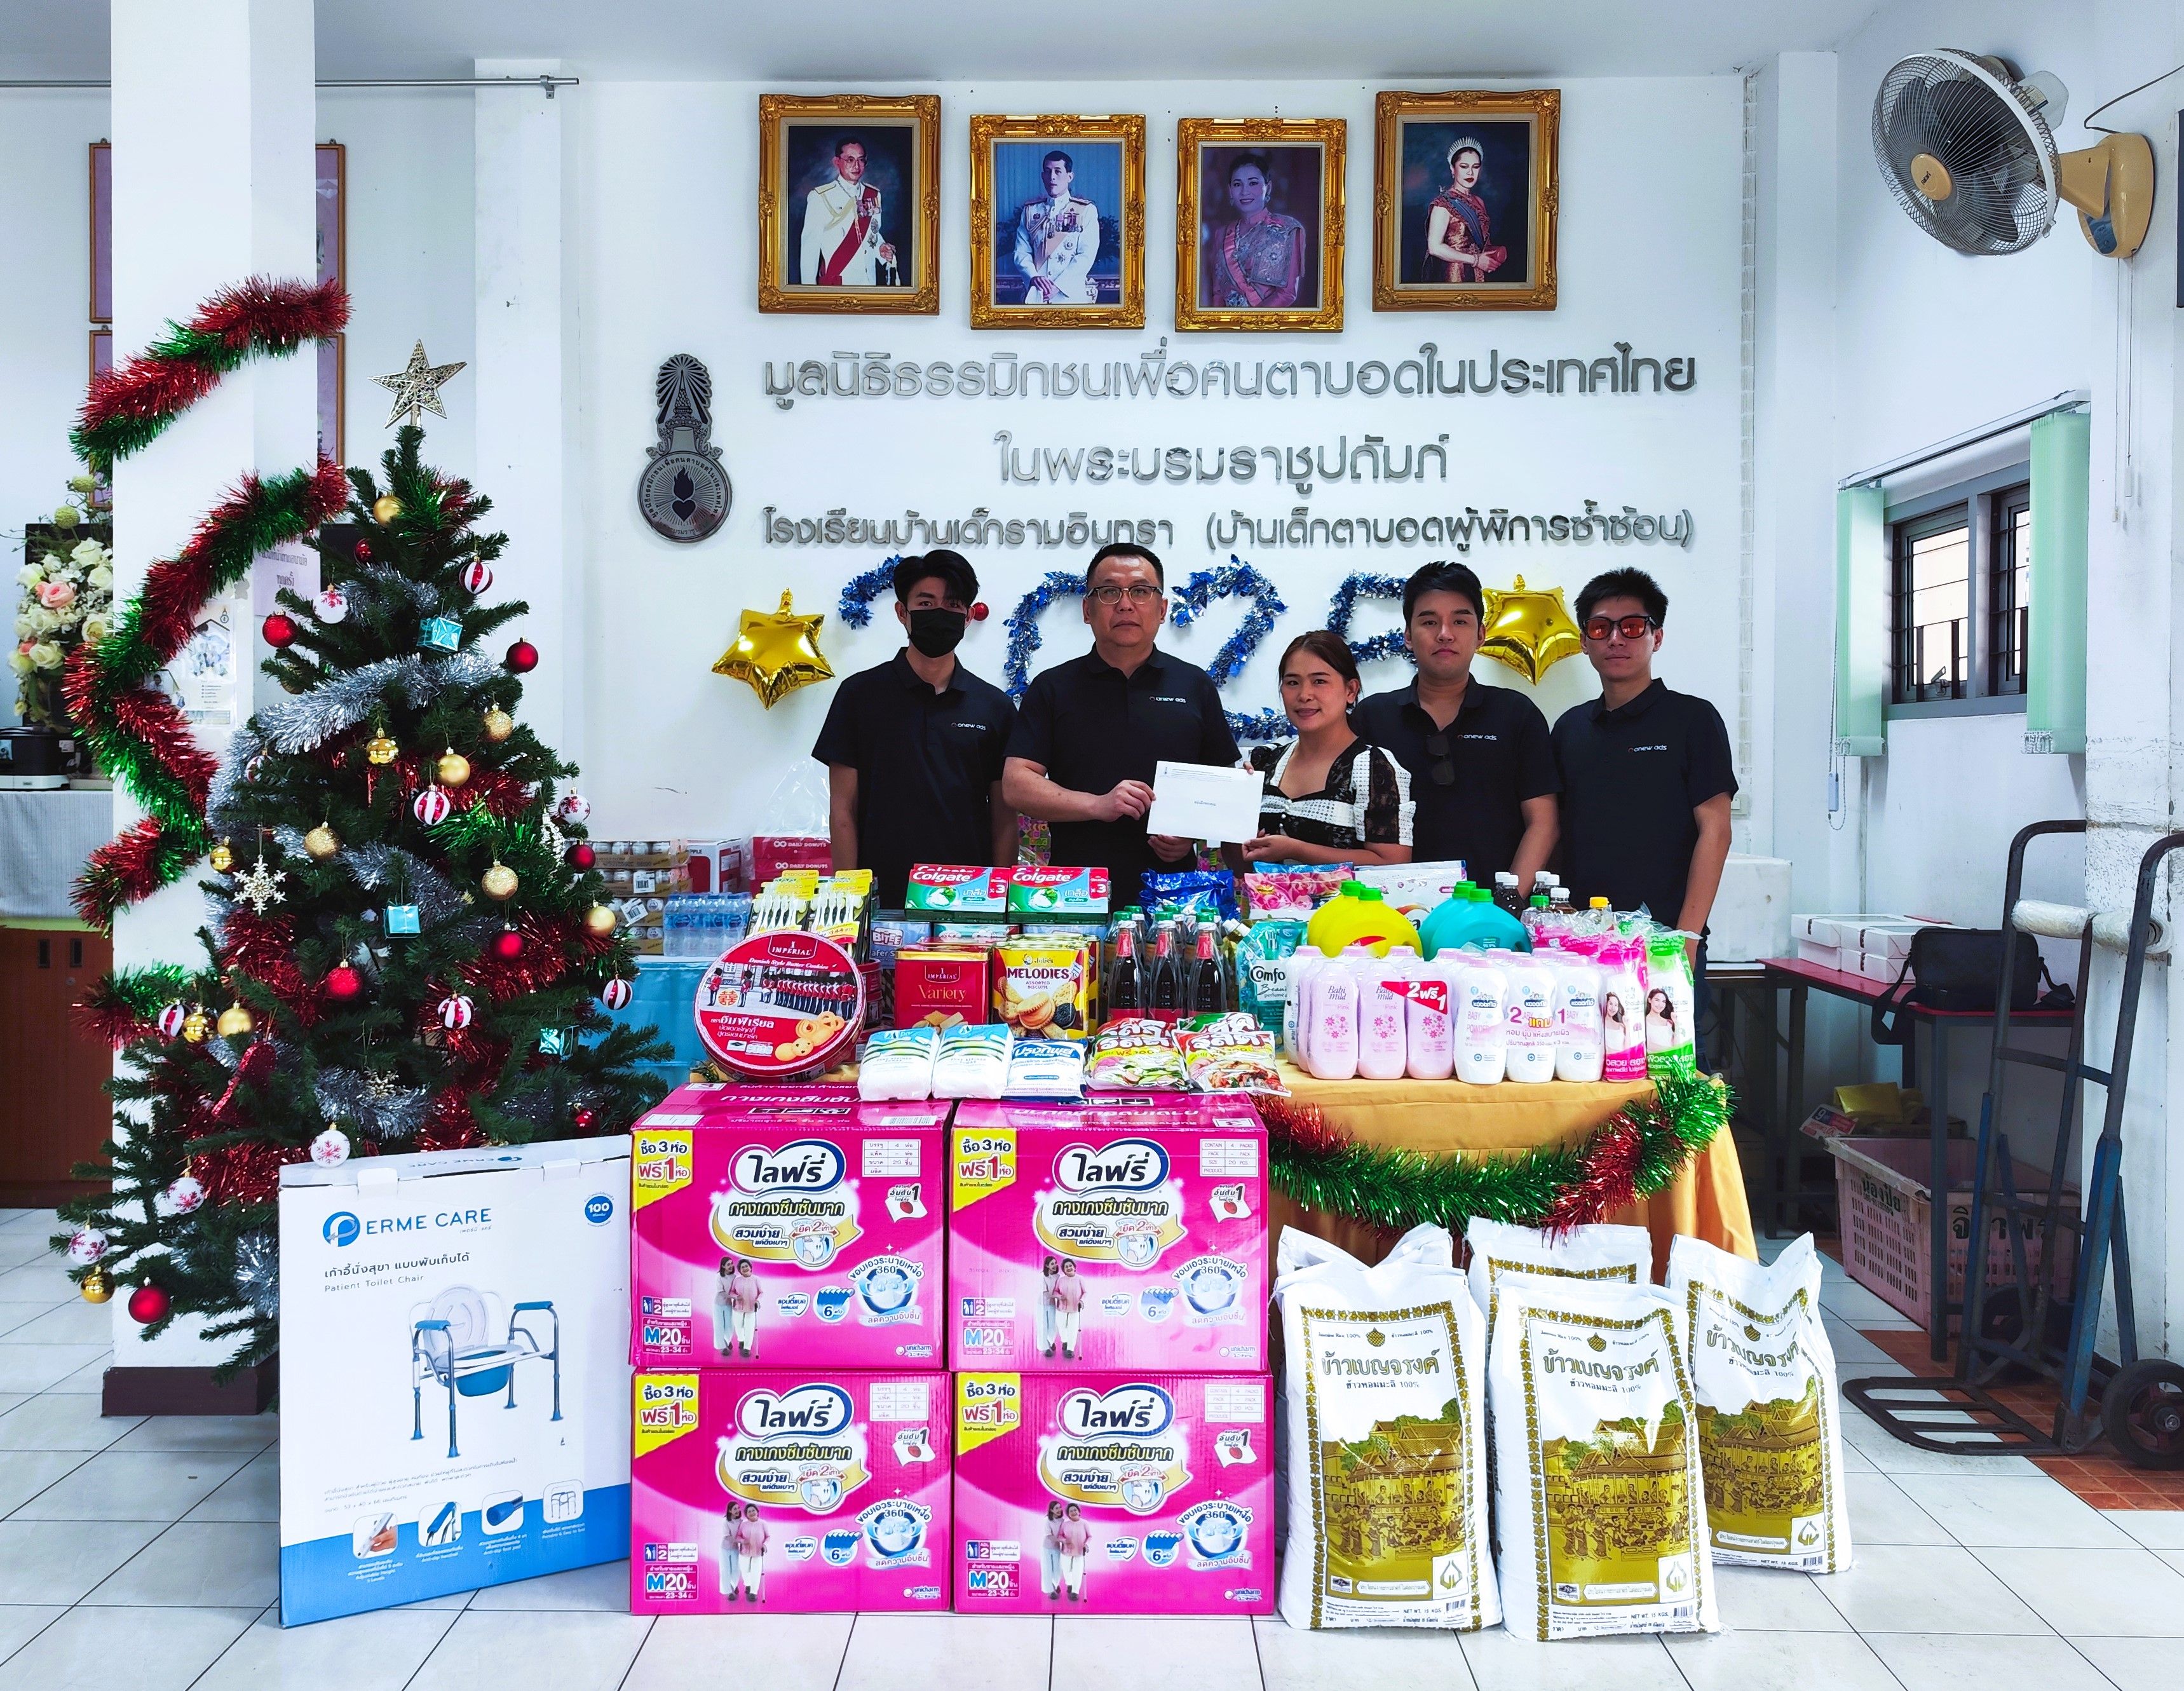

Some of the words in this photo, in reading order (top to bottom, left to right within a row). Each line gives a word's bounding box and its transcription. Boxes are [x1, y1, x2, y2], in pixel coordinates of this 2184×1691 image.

[764, 337, 1696, 411] มูลนิธิธรรมิกชนเพื่อคนตาบอดในประเทศไทย
[994, 430, 1449, 494] ในพระบรมราชูปถัมภ์
[763, 506, 1173, 547] โรงเรียนบ้านเด็กรามอินทรา
[976, 724, 987, 733] ads
[912, 872, 971, 882] Colgate
[1013, 872, 1071, 882] Colgate
[963, 888, 987, 896] เกลือ
[996, 885, 1005, 893] 3
[1064, 888, 1089, 897] เกลือ
[1097, 884, 1106, 893] 3
[872, 932, 902, 946] BITEE
[772, 946, 811, 956] IMPERIAL
[1007, 968, 1069, 979] MELODIES
[1251, 965, 1286, 984] Comfo
[919, 984, 966, 1002] Variety
[1327, 986, 1346, 994] Babi
[1406, 982, 1420, 998] 2
[1419, 986, 1439, 1000] ฟรี
[1437, 994, 1446, 1010] 1
[1510, 1007, 1522, 1024] 2
[1529, 1017, 1552, 1028] แถม
[1558, 1008, 1565, 1024] 1
[659, 1141, 668, 1151] 3
[670, 1142, 688, 1153] ห่อ
[982, 1140, 992, 1150] 3
[994, 1139, 1012, 1152] ห่อ
[639, 1162, 661, 1179] ฟรี
[665, 1157, 674, 1180] 1
[748, 1153, 827, 1183] ไลฟ์รี่
[960, 1161, 986, 1178] ฟรี
[988, 1157, 998, 1179] 1
[1071, 1151, 1149, 1183] ไลฟ์รี่
[588, 1202, 610, 1213] 100
[729, 1199, 844, 1217] กางเกงซึมซับมาก
[1052, 1198, 1169, 1216] กางเกงซึมซับมาก
[435, 1208, 492, 1226] CARE
[735, 1225, 780, 1239] สวมง่าย
[812, 1222, 822, 1232] 2
[1059, 1225, 1104, 1239] สวมง่าย
[1136, 1219, 1145, 1232] 2
[325, 1261, 390, 1278] เก้าอี้นั่งสุขา
[395, 1252, 470, 1270] แบบพับเก็บได้
[325, 1281, 361, 1293] Patient
[366, 1278, 393, 1288] Toilet
[398, 1274, 424, 1284] Chair
[824, 1307, 832, 1317] 6
[1322, 1349, 1440, 1376] ข้าวเบญจรงค์
[1543, 1347, 1660, 1381] ข้าวเบญจรงค์
[986, 1384, 996, 1394] 3
[1346, 1380, 1396, 1389] ข้าวหอมมะลิ
[754, 1397, 833, 1428] ไลฟ์รี่
[965, 1406, 989, 1421] ฟรี
[1076, 1397, 1155, 1428] ไลฟ์รี่
[735, 1444, 853, 1461] กางเกงซึมซับมาก
[1057, 1444, 1174, 1461] กางเกงซึมซับมาก
[742, 1471, 787, 1484] สวมง่าย
[1064, 1471, 1108, 1484] สวมง่าย
